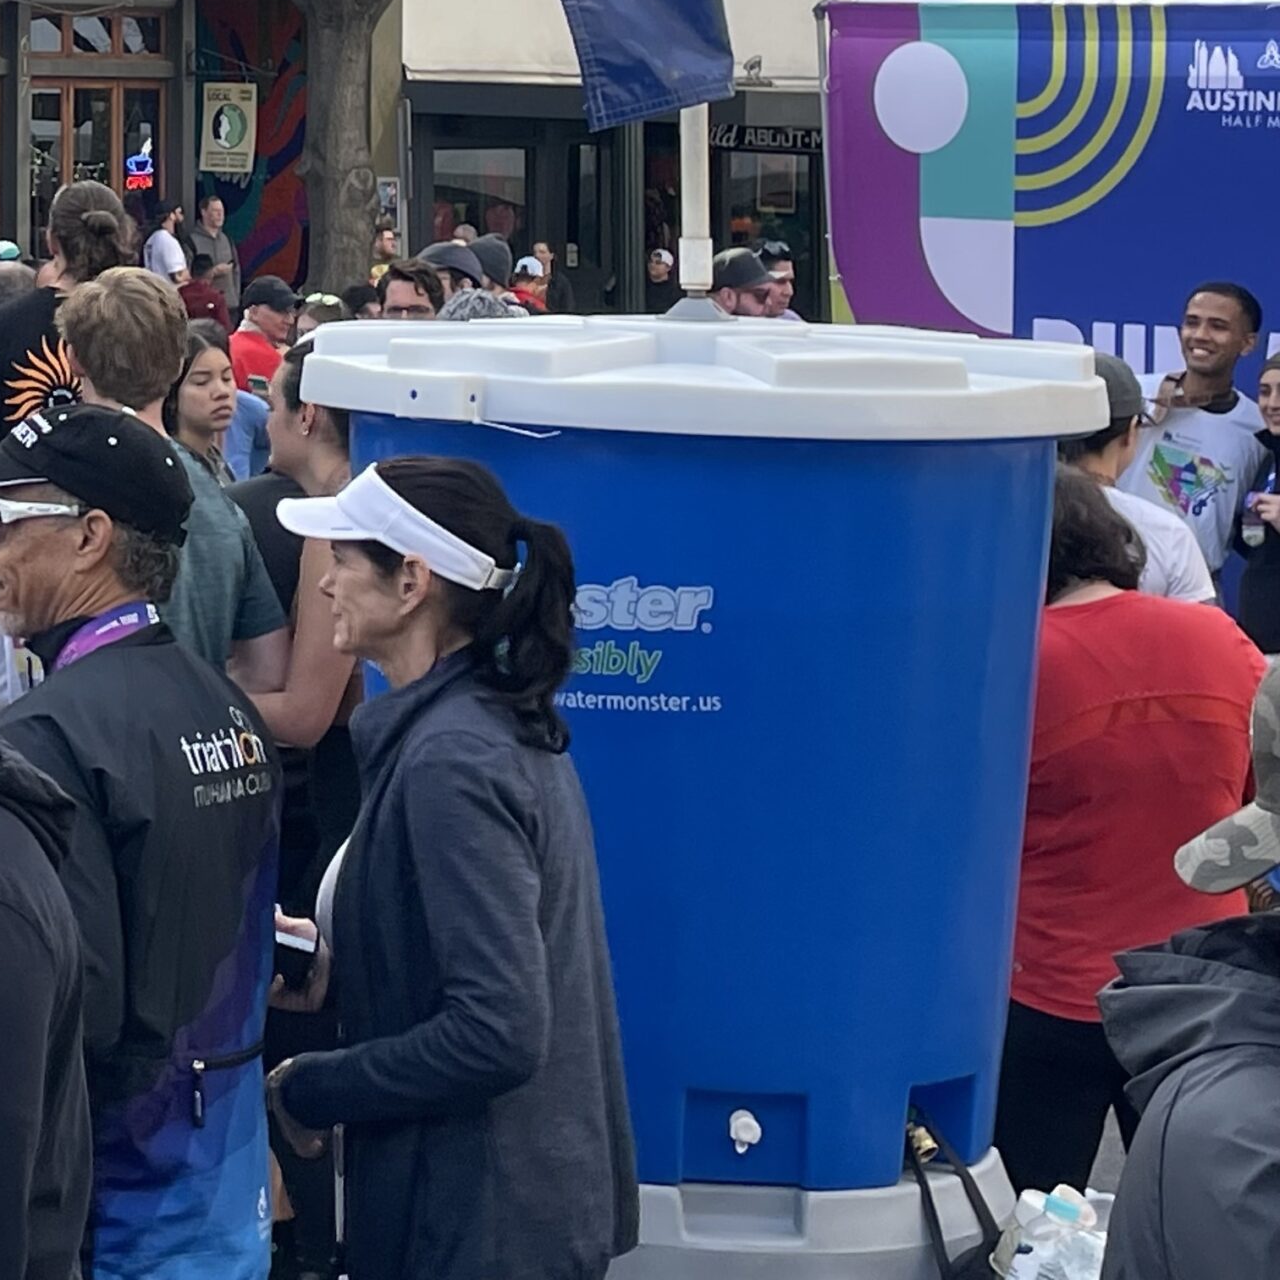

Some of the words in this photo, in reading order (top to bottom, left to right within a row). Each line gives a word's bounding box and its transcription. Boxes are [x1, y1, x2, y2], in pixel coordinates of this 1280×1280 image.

[1186, 91, 1280, 111] AUSTIN
[1221, 114, 1262, 129] HALF
[709, 123, 739, 148] ild
[570, 576, 714, 632] ster
[571, 640, 662, 684] sibly
